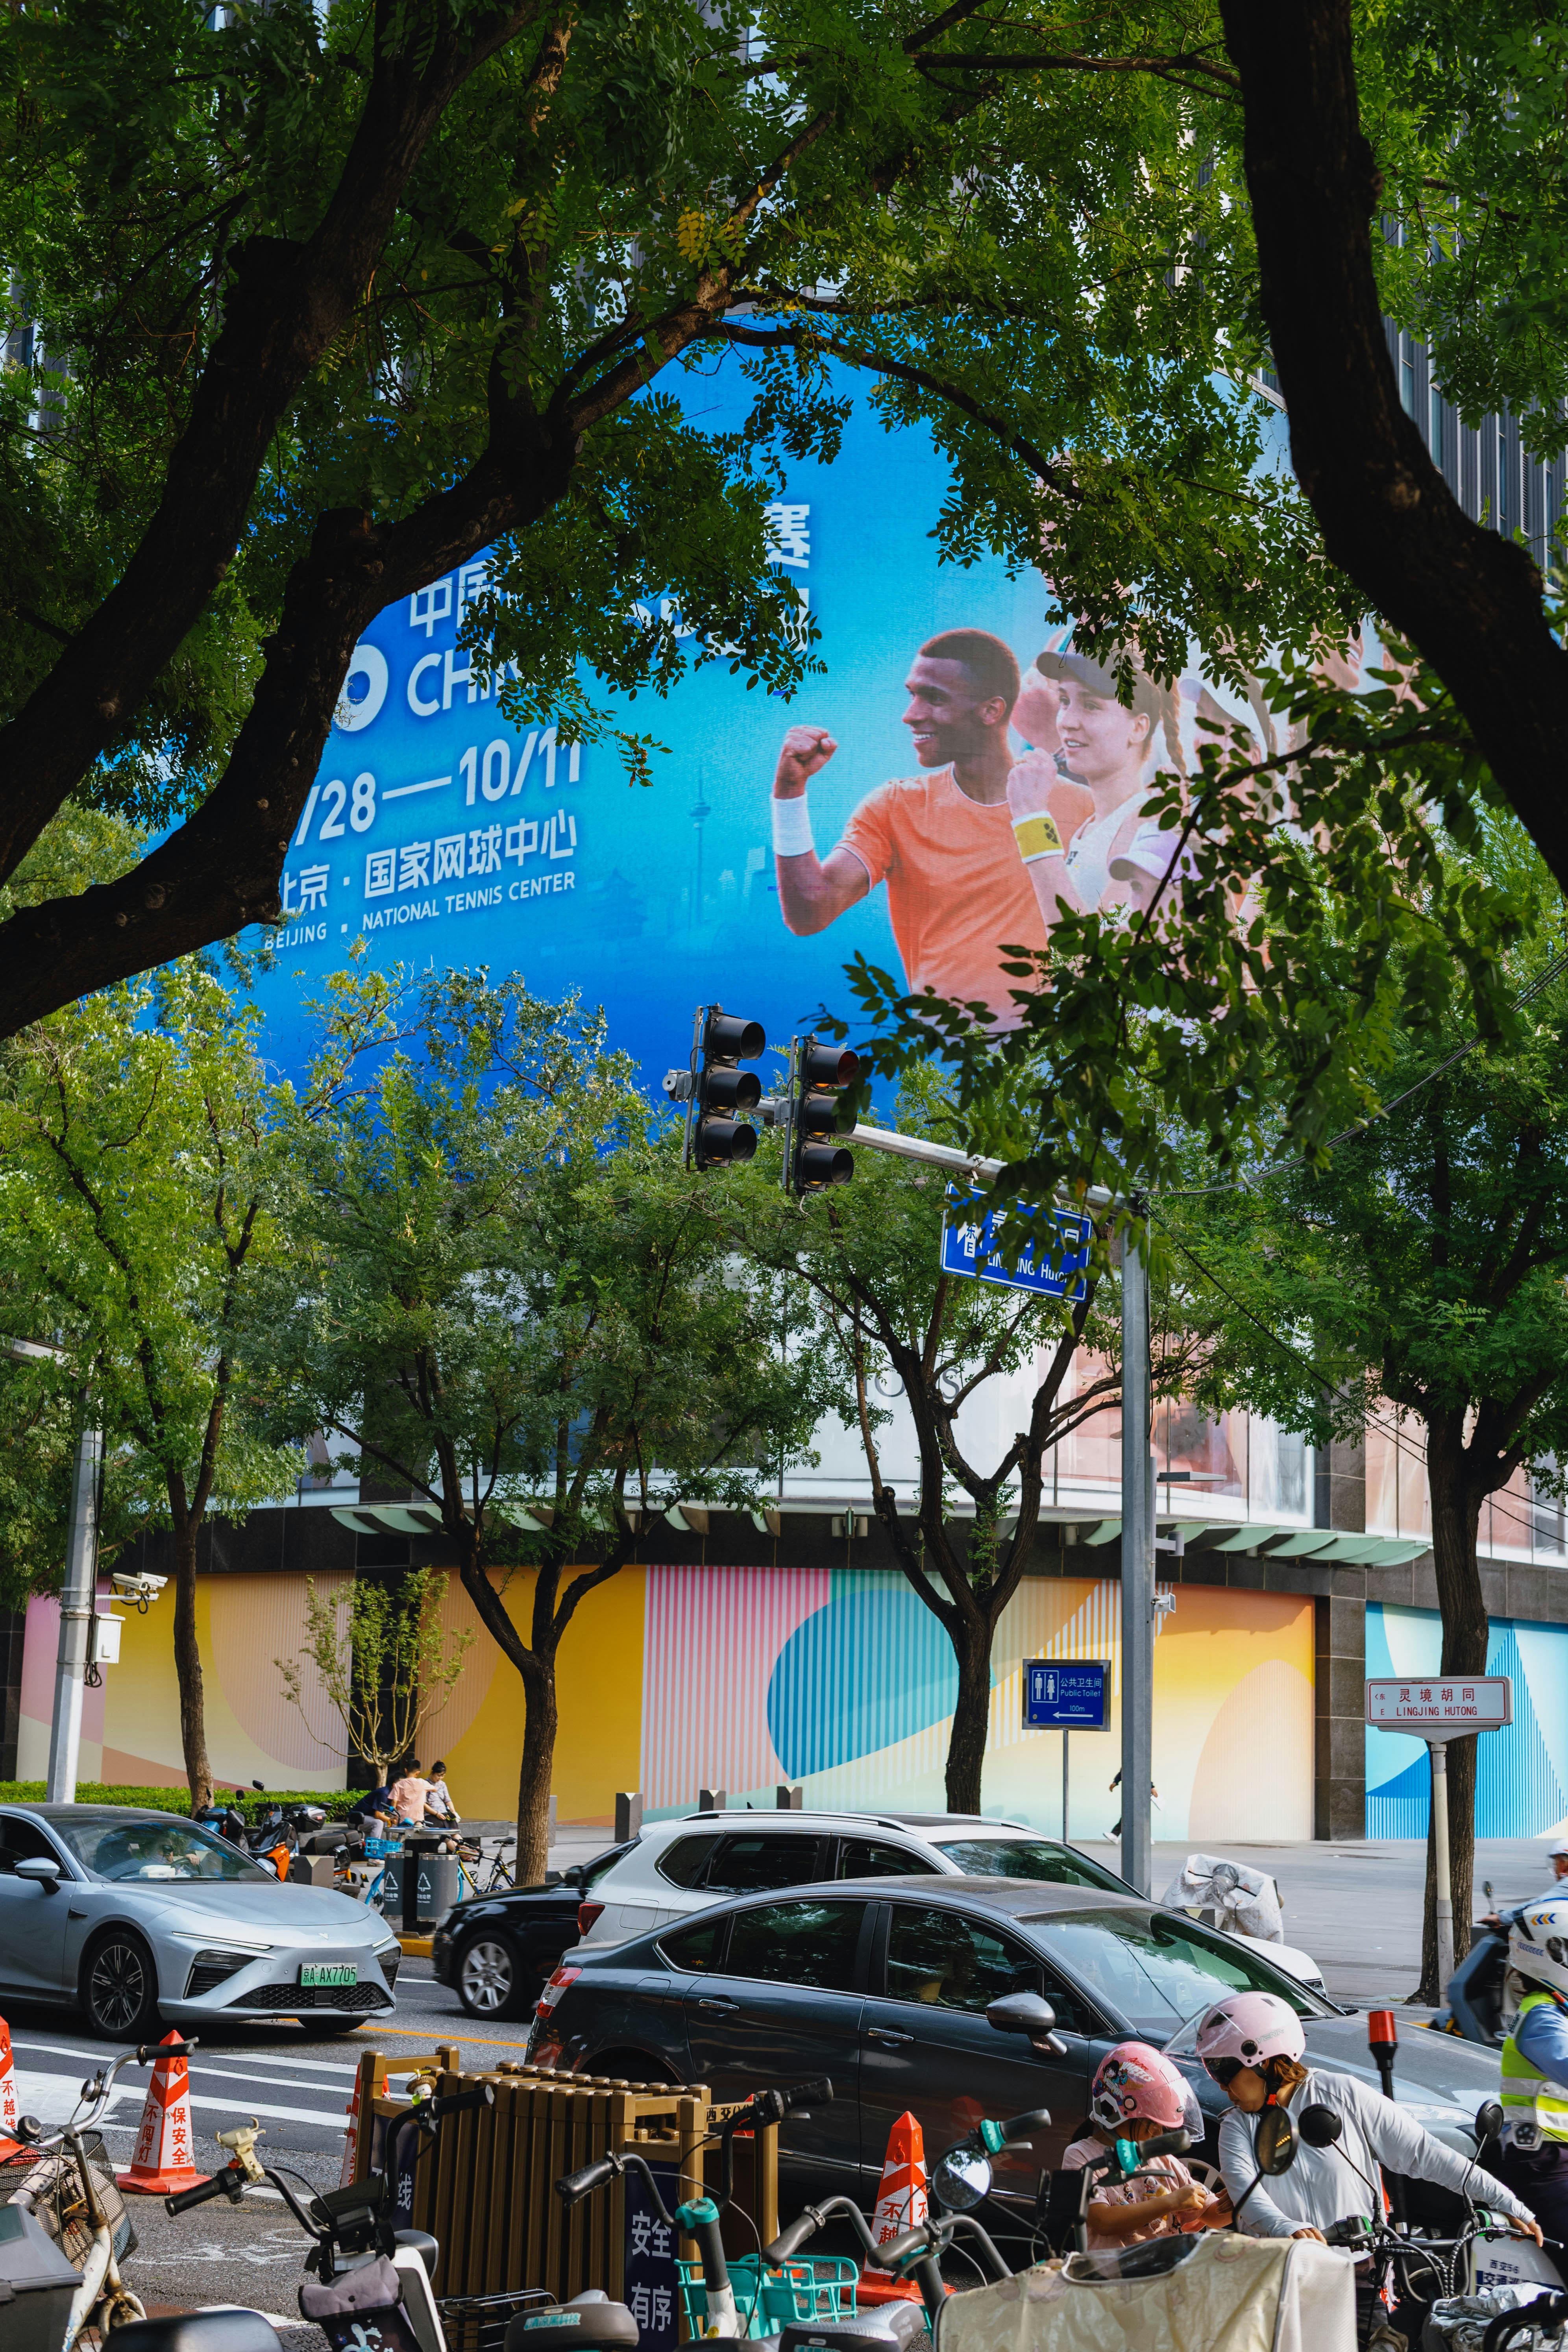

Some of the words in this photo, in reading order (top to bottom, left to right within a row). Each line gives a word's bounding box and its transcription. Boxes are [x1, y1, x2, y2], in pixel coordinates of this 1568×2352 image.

[362, 899, 440, 931] NATIONAL
[445, 886, 503, 913] TENNIS
[508, 871, 575, 900] CENTER
[967, 1242, 973, 1254] E
[987, 1250, 1035, 1276] LINING
[1060, 1677, 1102, 1688] 公共卫生间
[1399, 1688, 1475, 1702] 灵境胡同
[1396, 1707, 1439, 1716] LINGJING
[1444, 1706, 1477, 1716] HUTONG
[172, 2107, 187, 2165] 保安全
[632, 2210, 671, 2258] 安全
[631, 2282, 671, 2331] 有序
